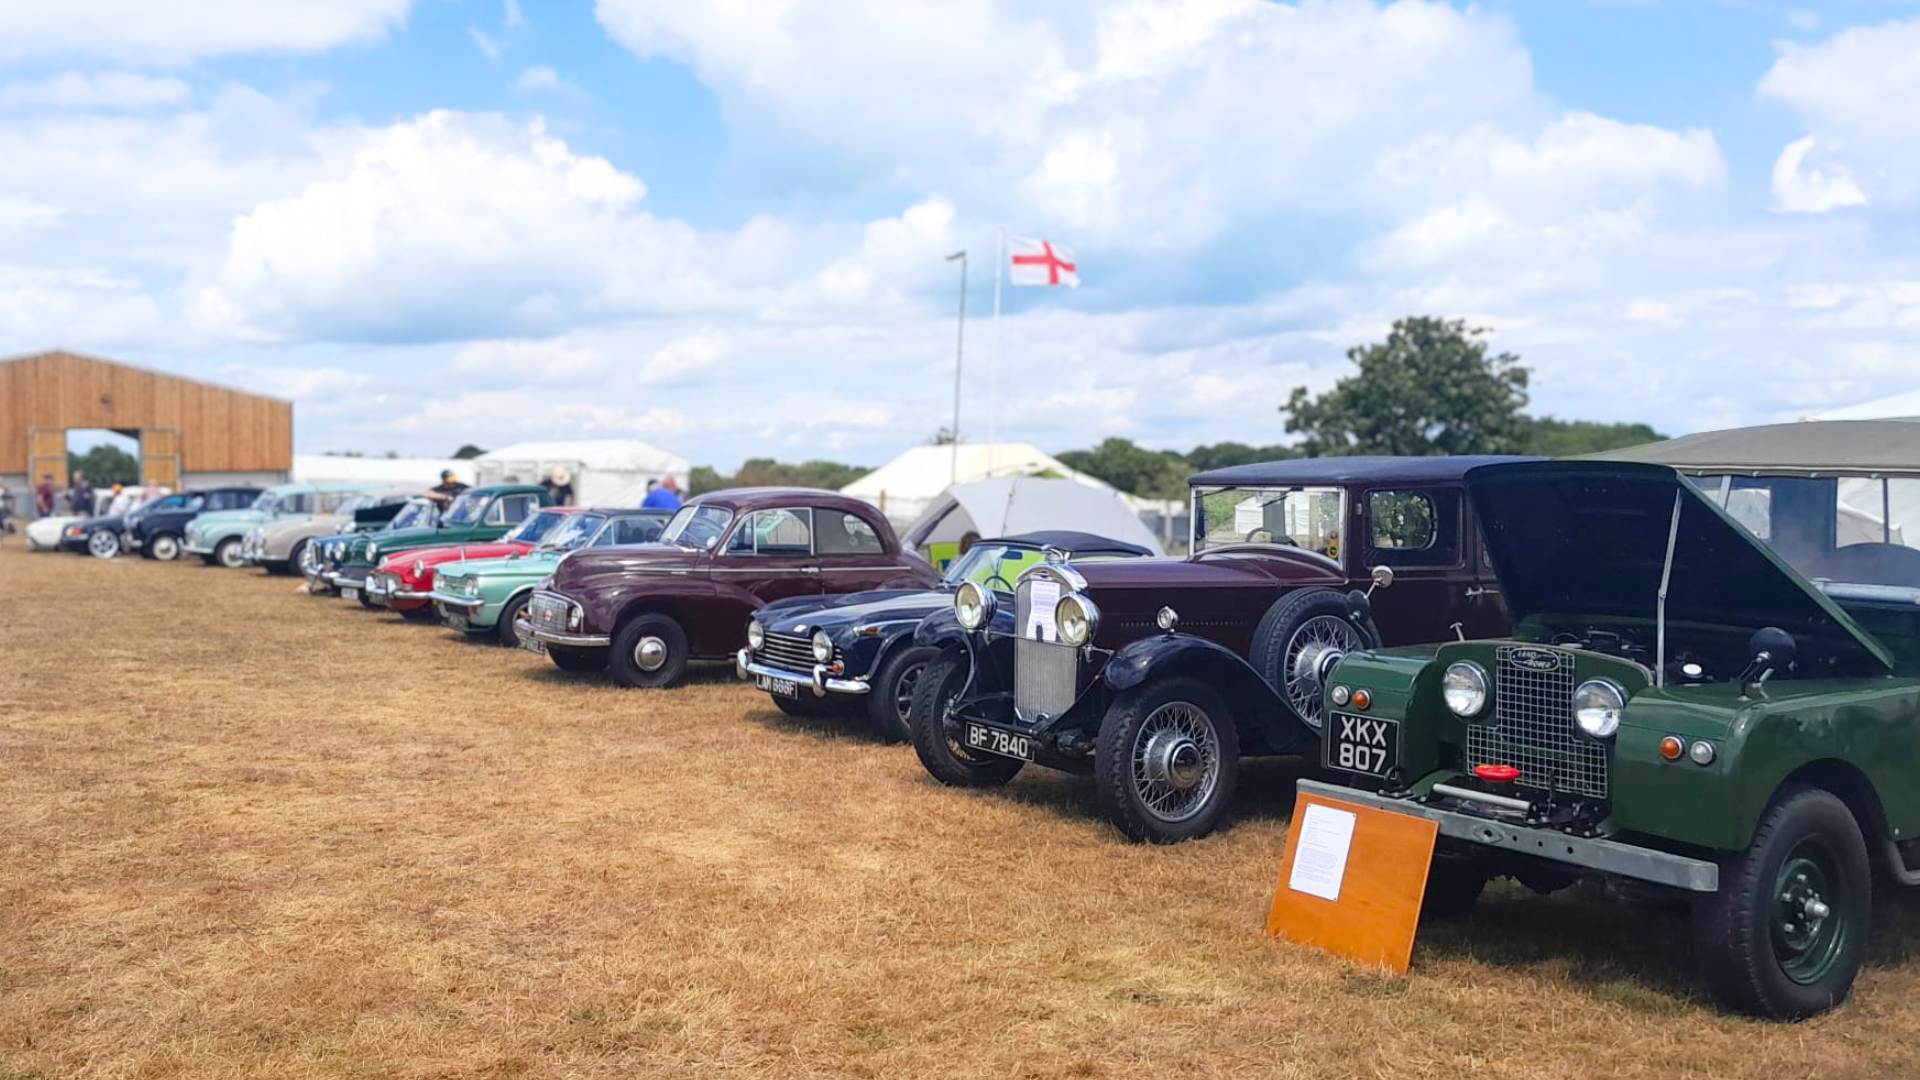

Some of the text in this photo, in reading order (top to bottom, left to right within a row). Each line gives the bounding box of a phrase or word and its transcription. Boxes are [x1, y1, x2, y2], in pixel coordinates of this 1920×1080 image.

[969, 725, 1028, 758] BF 7840
[1340, 715, 1387, 747] XKX
[1339, 742, 1387, 773] 807
